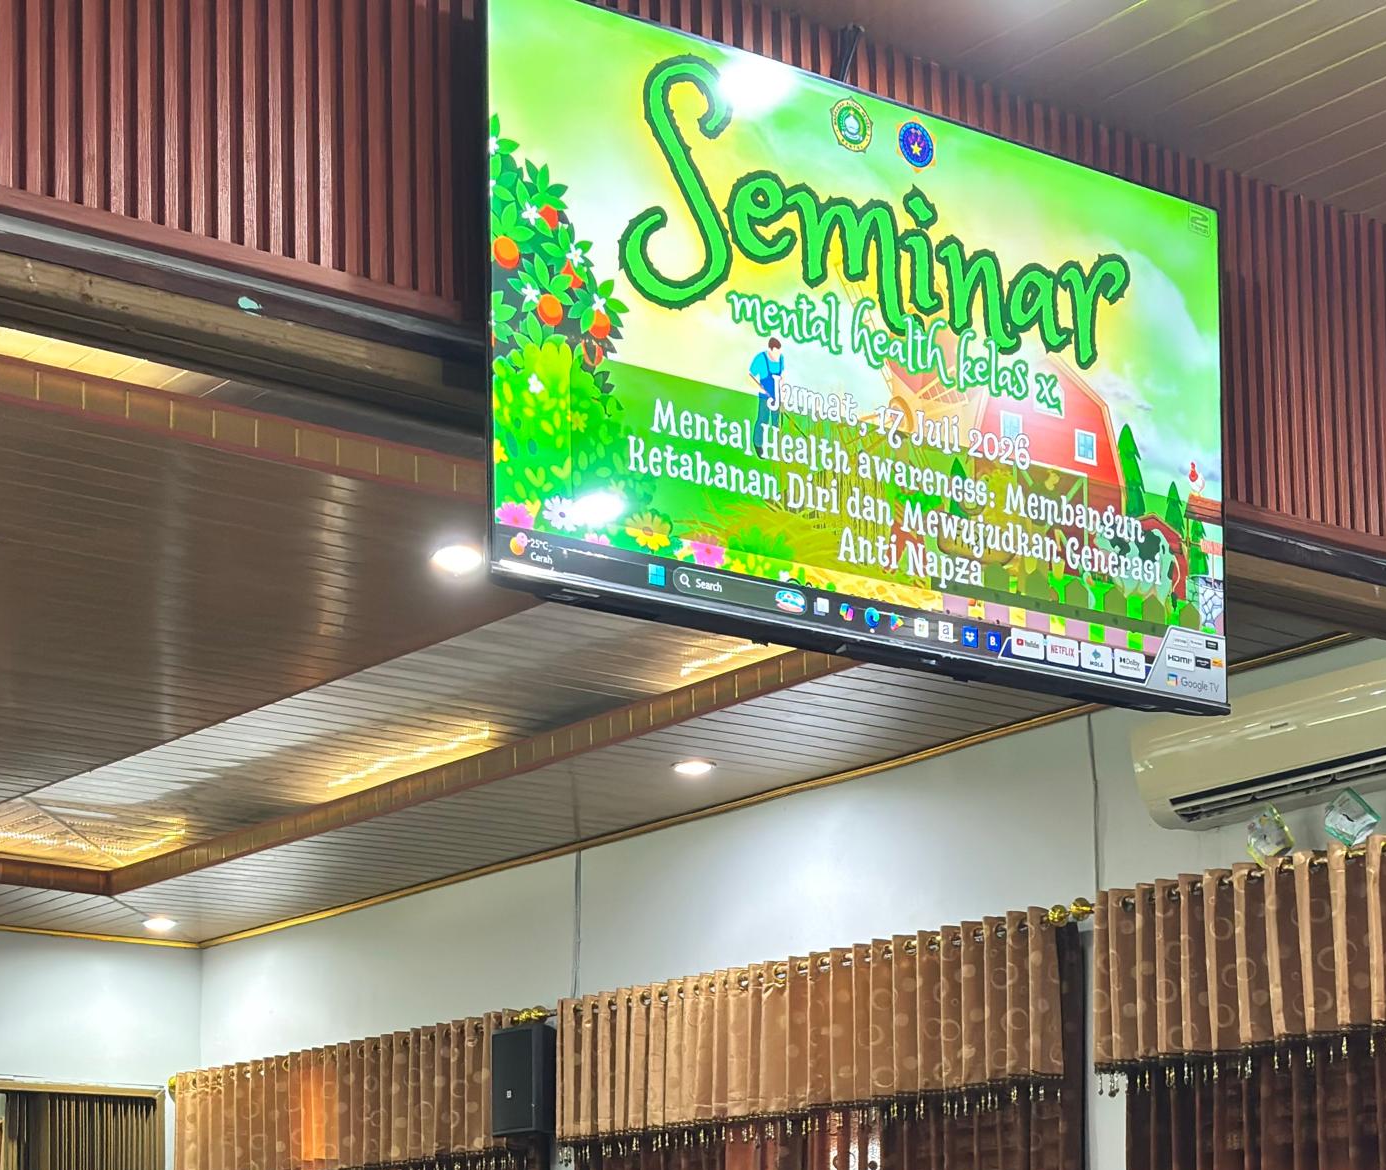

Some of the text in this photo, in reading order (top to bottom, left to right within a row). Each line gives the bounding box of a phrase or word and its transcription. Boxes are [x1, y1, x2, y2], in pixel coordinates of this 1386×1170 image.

[619, 54, 1130, 369] Seminar
[726, 290, 1063, 416] mental health kelas x
[767, 374, 1032, 471] Jumat, 17 Juli 2026
[627, 435, 781, 501] Ketahanan
[787, 471, 840, 515] Diri
[847, 488, 894, 526] dan
[901, 500, 1063, 563] Mewujudkan
[1066, 537, 1163, 585] Generasi
[650, 398, 754, 456] Mental
[762, 422, 851, 476] Health
[858, 450, 995, 509] awareness:
[1004, 484, 1146, 544] Membangun
[530, 551, 553, 565] Cerah
[695, 577, 723, 594] Search
[837, 527, 899, 571] Anti
[906, 540, 984, 589] Napza
[1050, 644, 1075, 658] NETFLIX
[1181, 676, 1221, 693] Google TV
